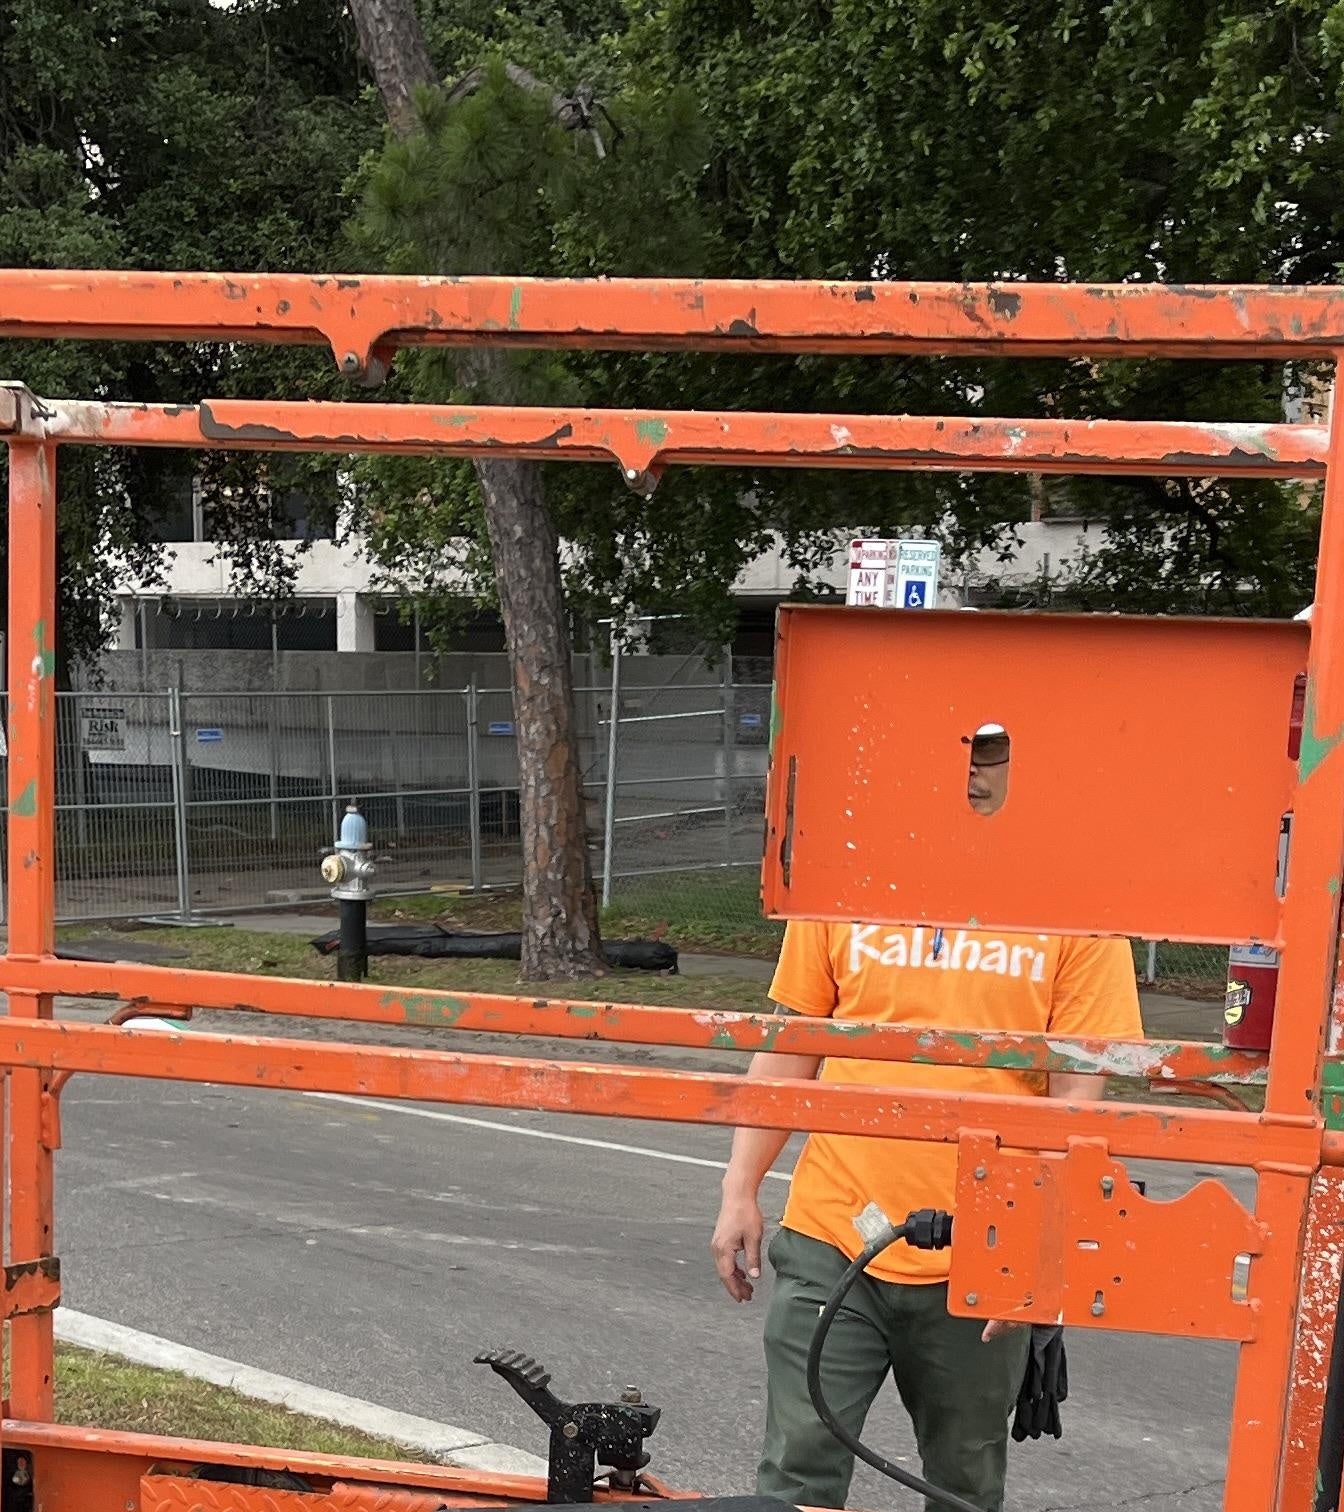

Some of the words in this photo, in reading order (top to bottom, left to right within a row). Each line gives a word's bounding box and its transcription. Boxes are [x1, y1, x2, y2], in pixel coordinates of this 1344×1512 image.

[901, 565, 932, 576] PARKING
[857, 572, 879, 586] ANY
[855, 591, 878, 604] TIME
[848, 923, 1046, 982] Kalahari
